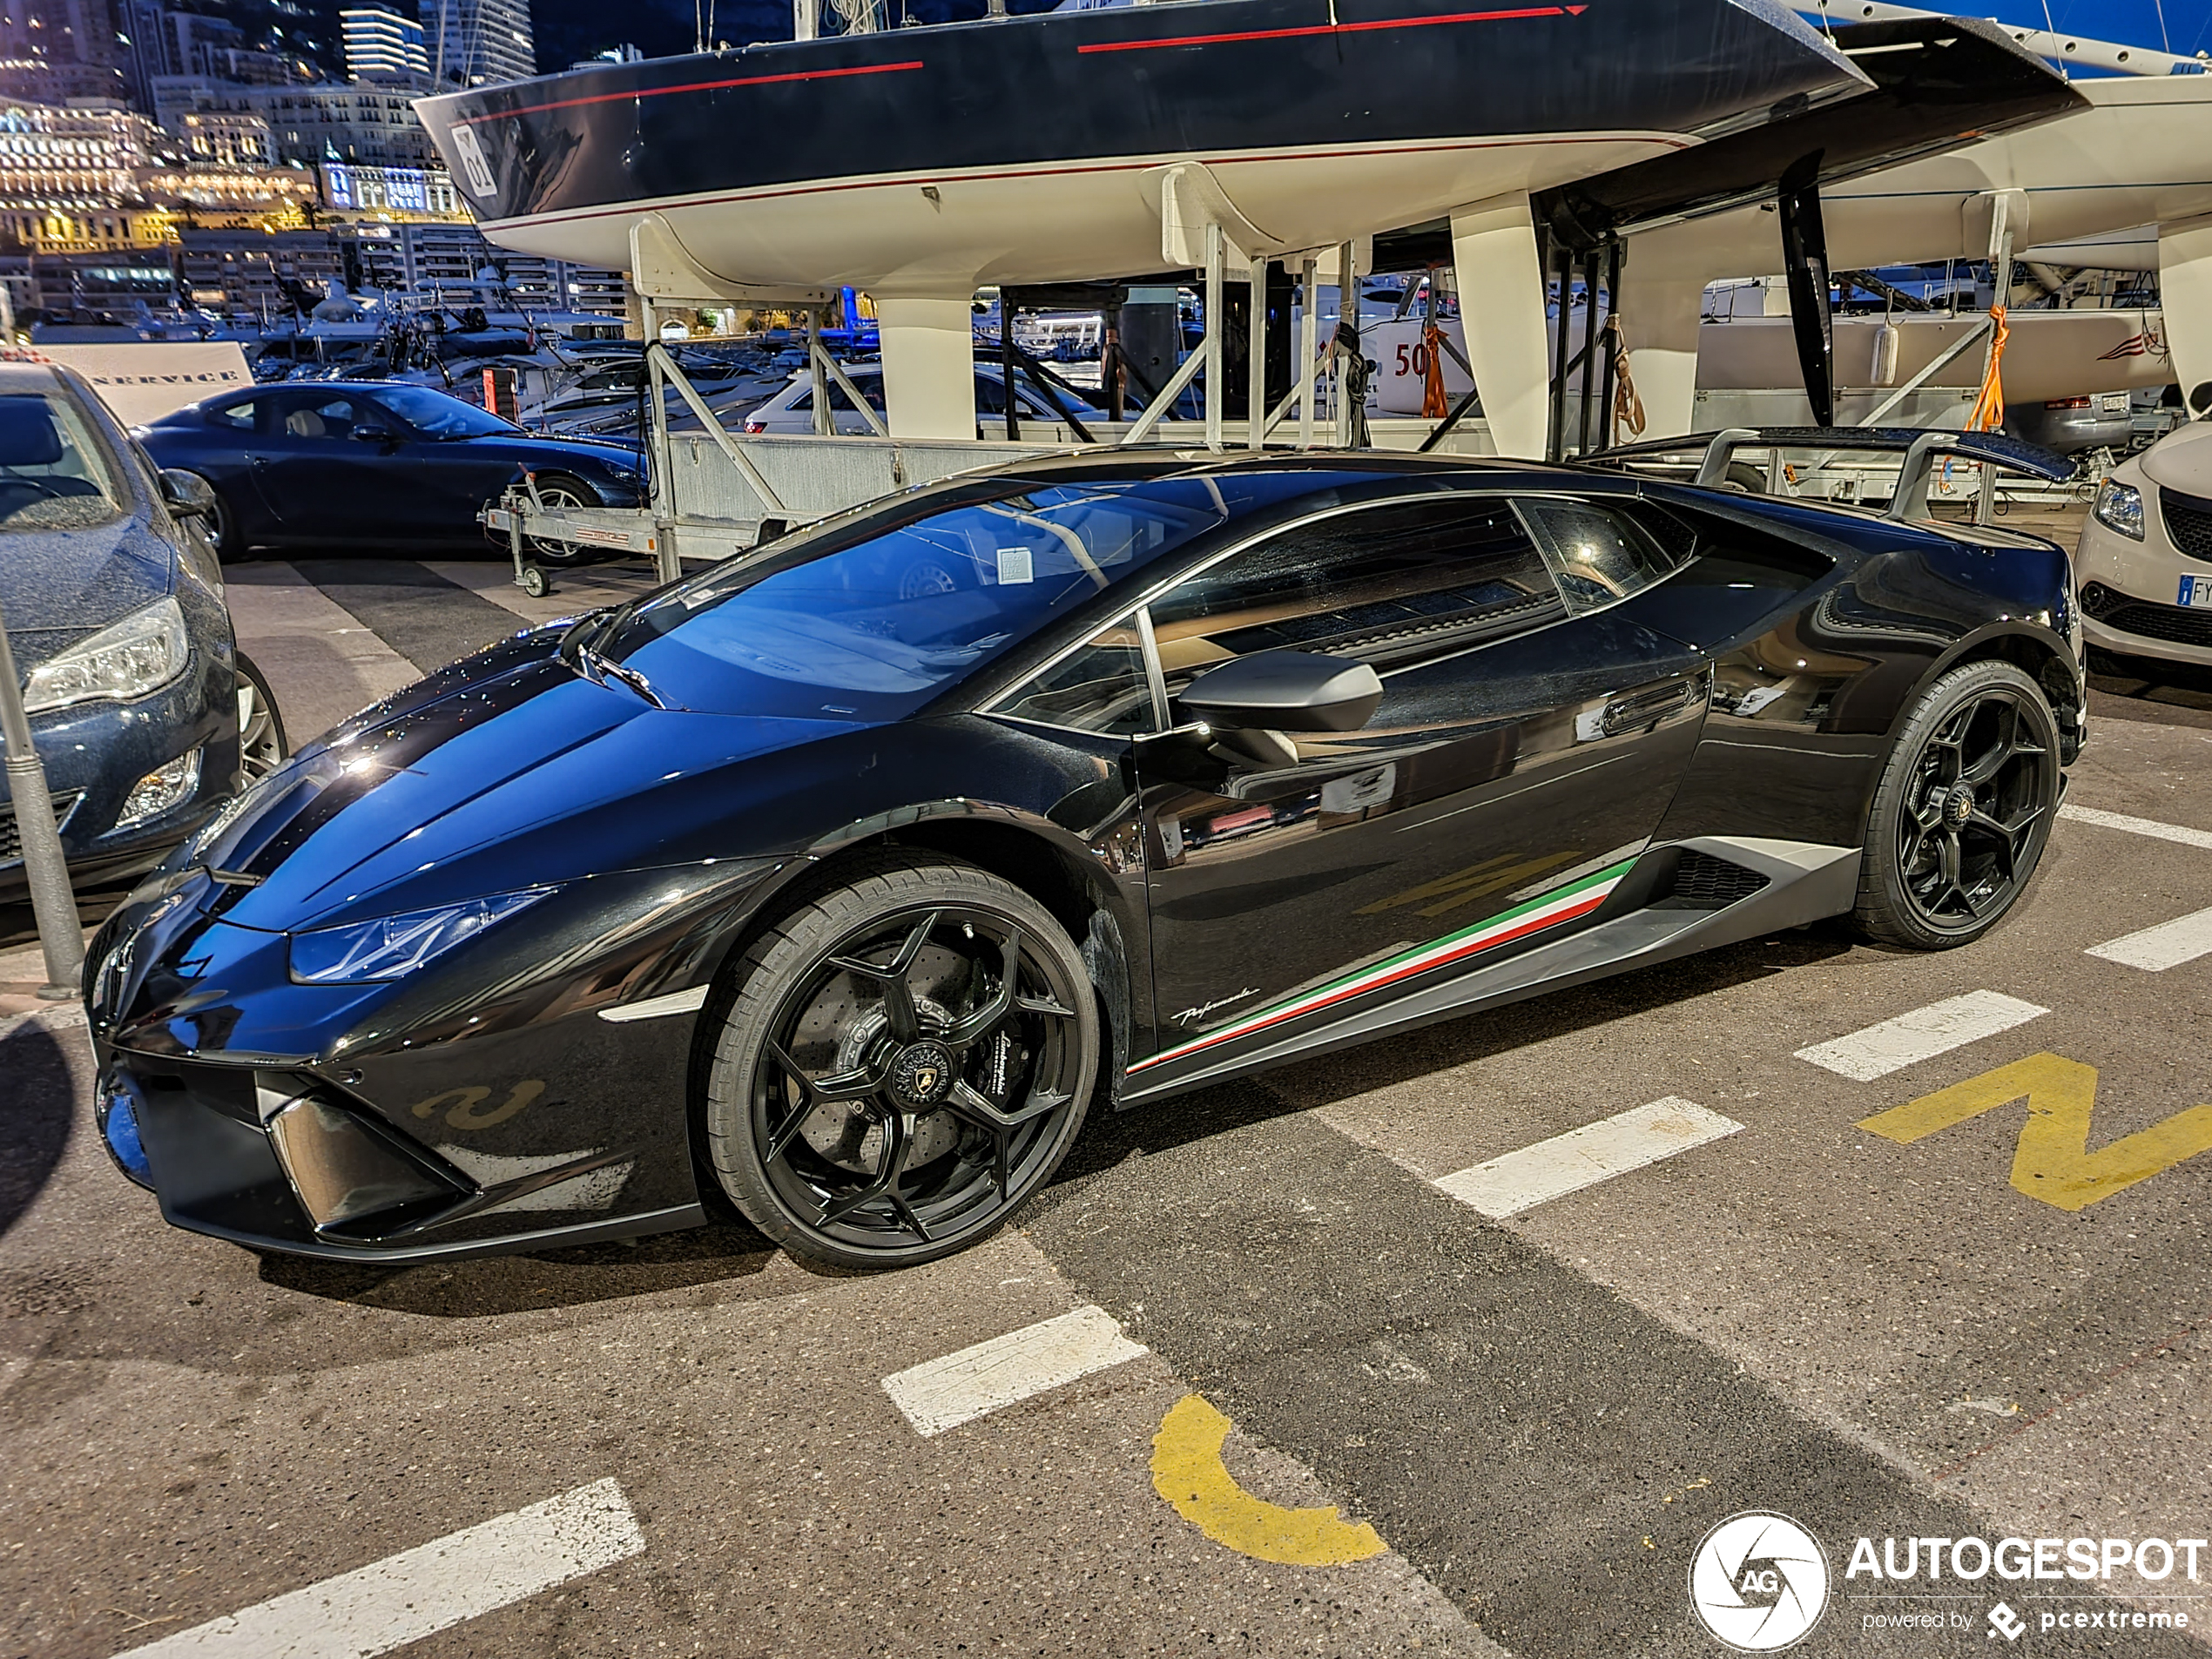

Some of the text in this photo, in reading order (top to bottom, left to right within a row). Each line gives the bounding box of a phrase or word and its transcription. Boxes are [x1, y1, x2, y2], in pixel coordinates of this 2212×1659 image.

[1395, 343, 1426, 376] 50
[92, 370, 239, 385] SERVICE
[2194, 582, 2212, 602] FY
[997, 1030, 1011, 1096] Lamborghini
